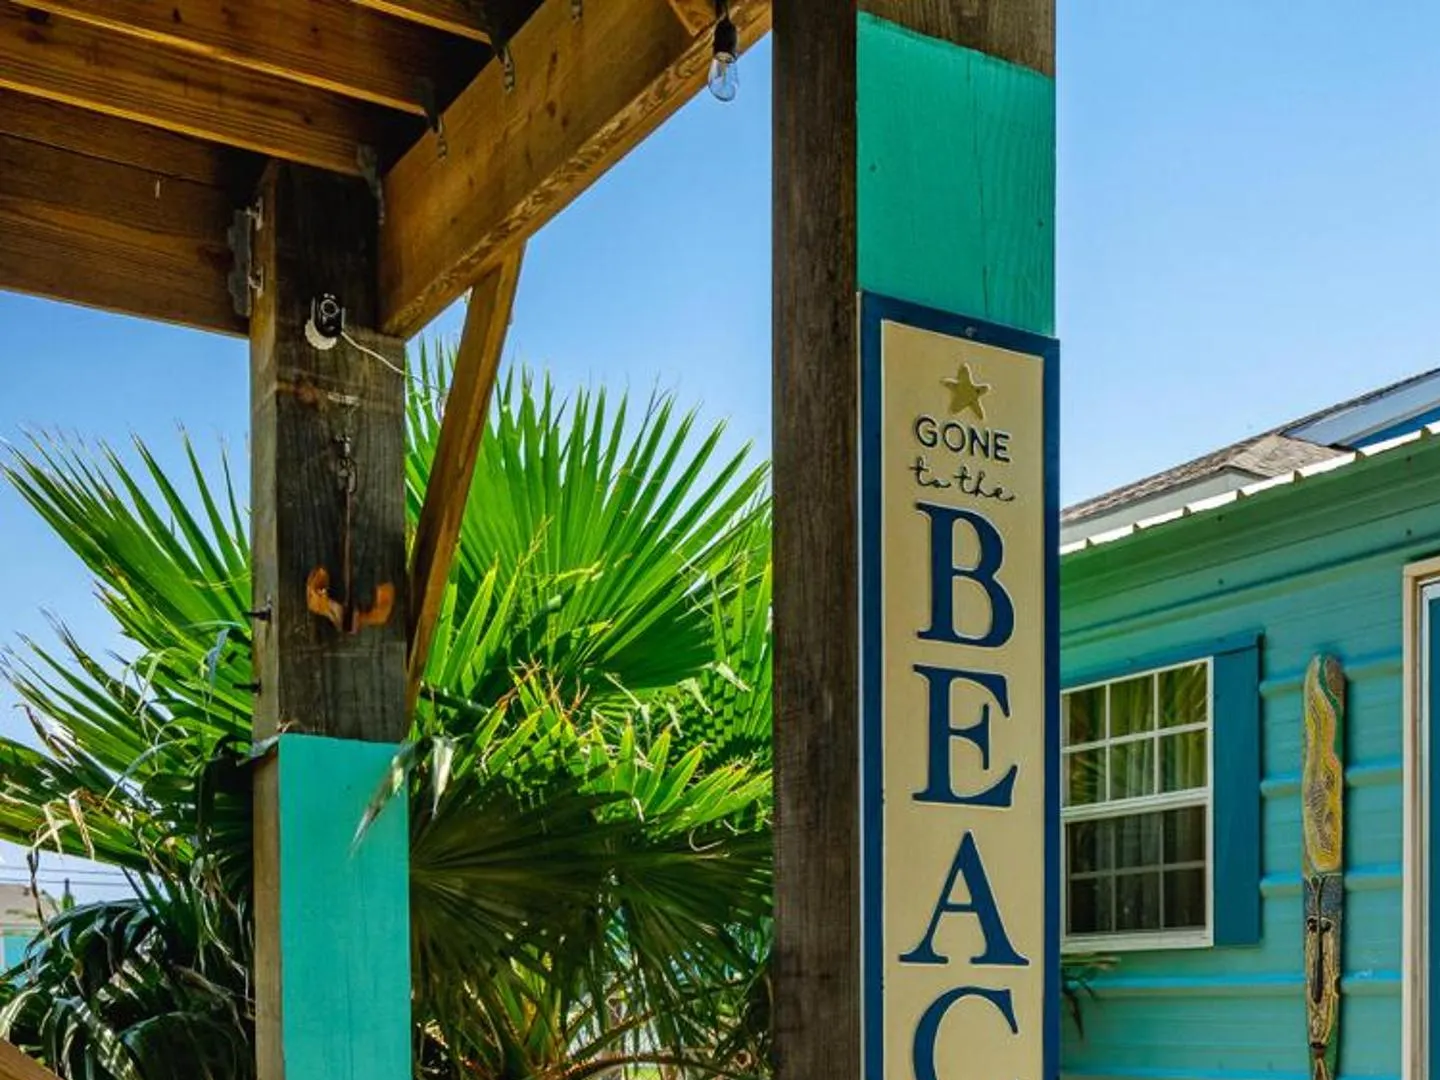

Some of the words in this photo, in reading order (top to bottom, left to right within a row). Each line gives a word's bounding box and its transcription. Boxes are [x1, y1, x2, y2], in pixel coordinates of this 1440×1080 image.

[914, 416, 1011, 463] GONE
[909, 456, 951, 487] to
[953, 466, 1016, 502] the
